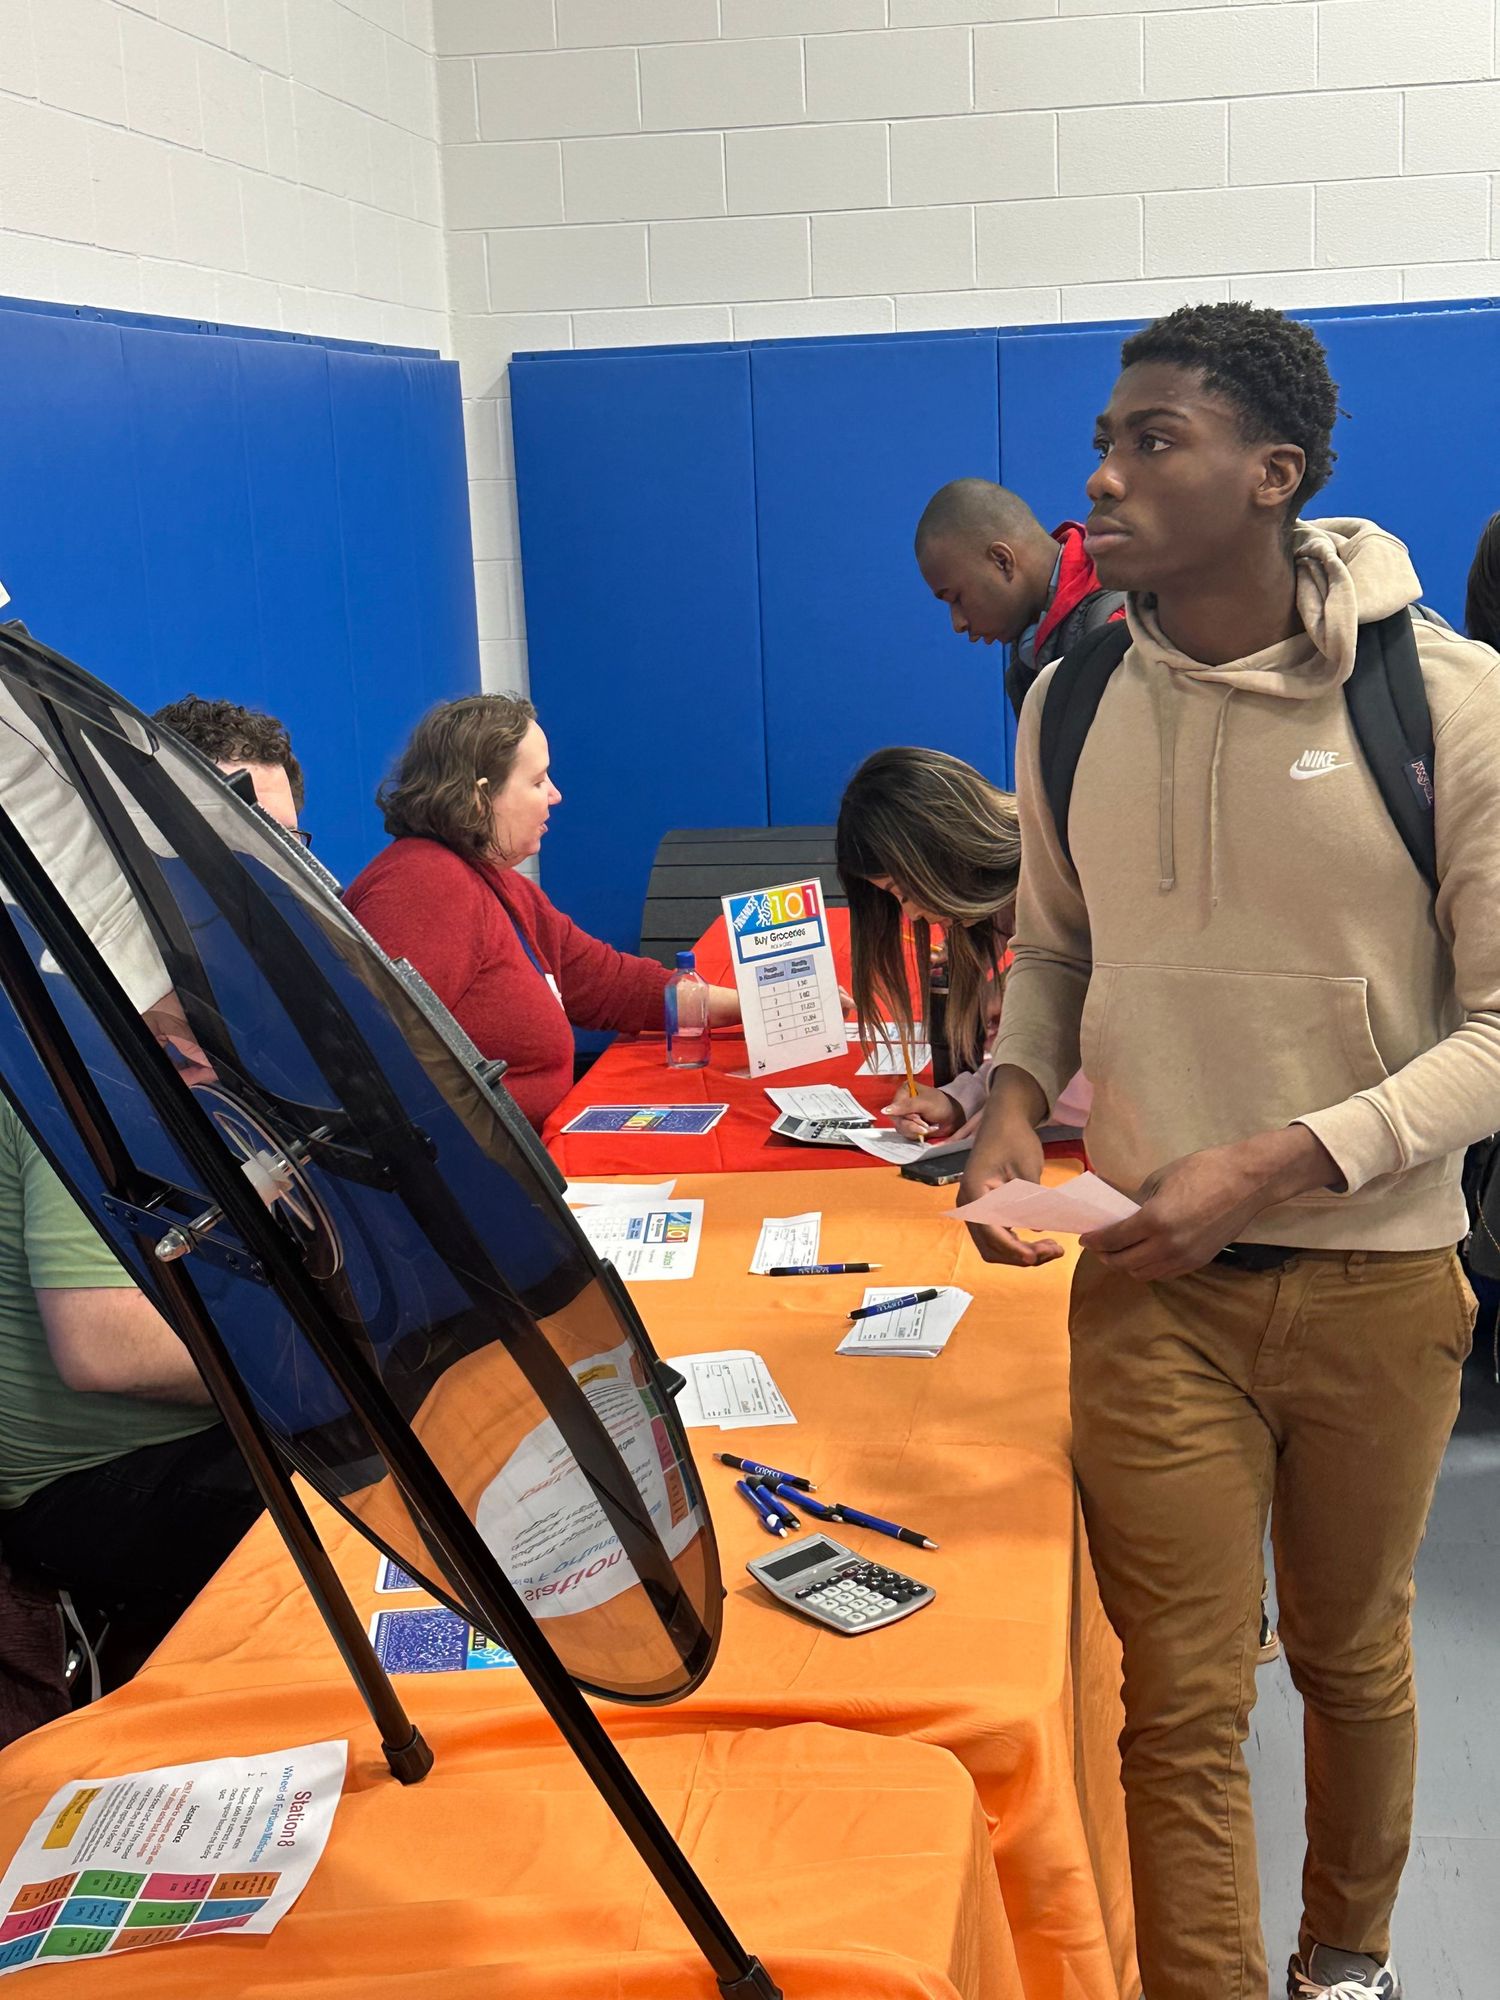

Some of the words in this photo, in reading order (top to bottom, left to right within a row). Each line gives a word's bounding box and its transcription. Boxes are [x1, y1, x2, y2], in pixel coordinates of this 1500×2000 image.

[1299, 749, 1340, 769] NIKE
[771, 888, 816, 921] 101
[770, 928, 806, 942] Groceries
[278, 1766, 294, 1792] Wheel
[280, 1791, 312, 1838] Station
